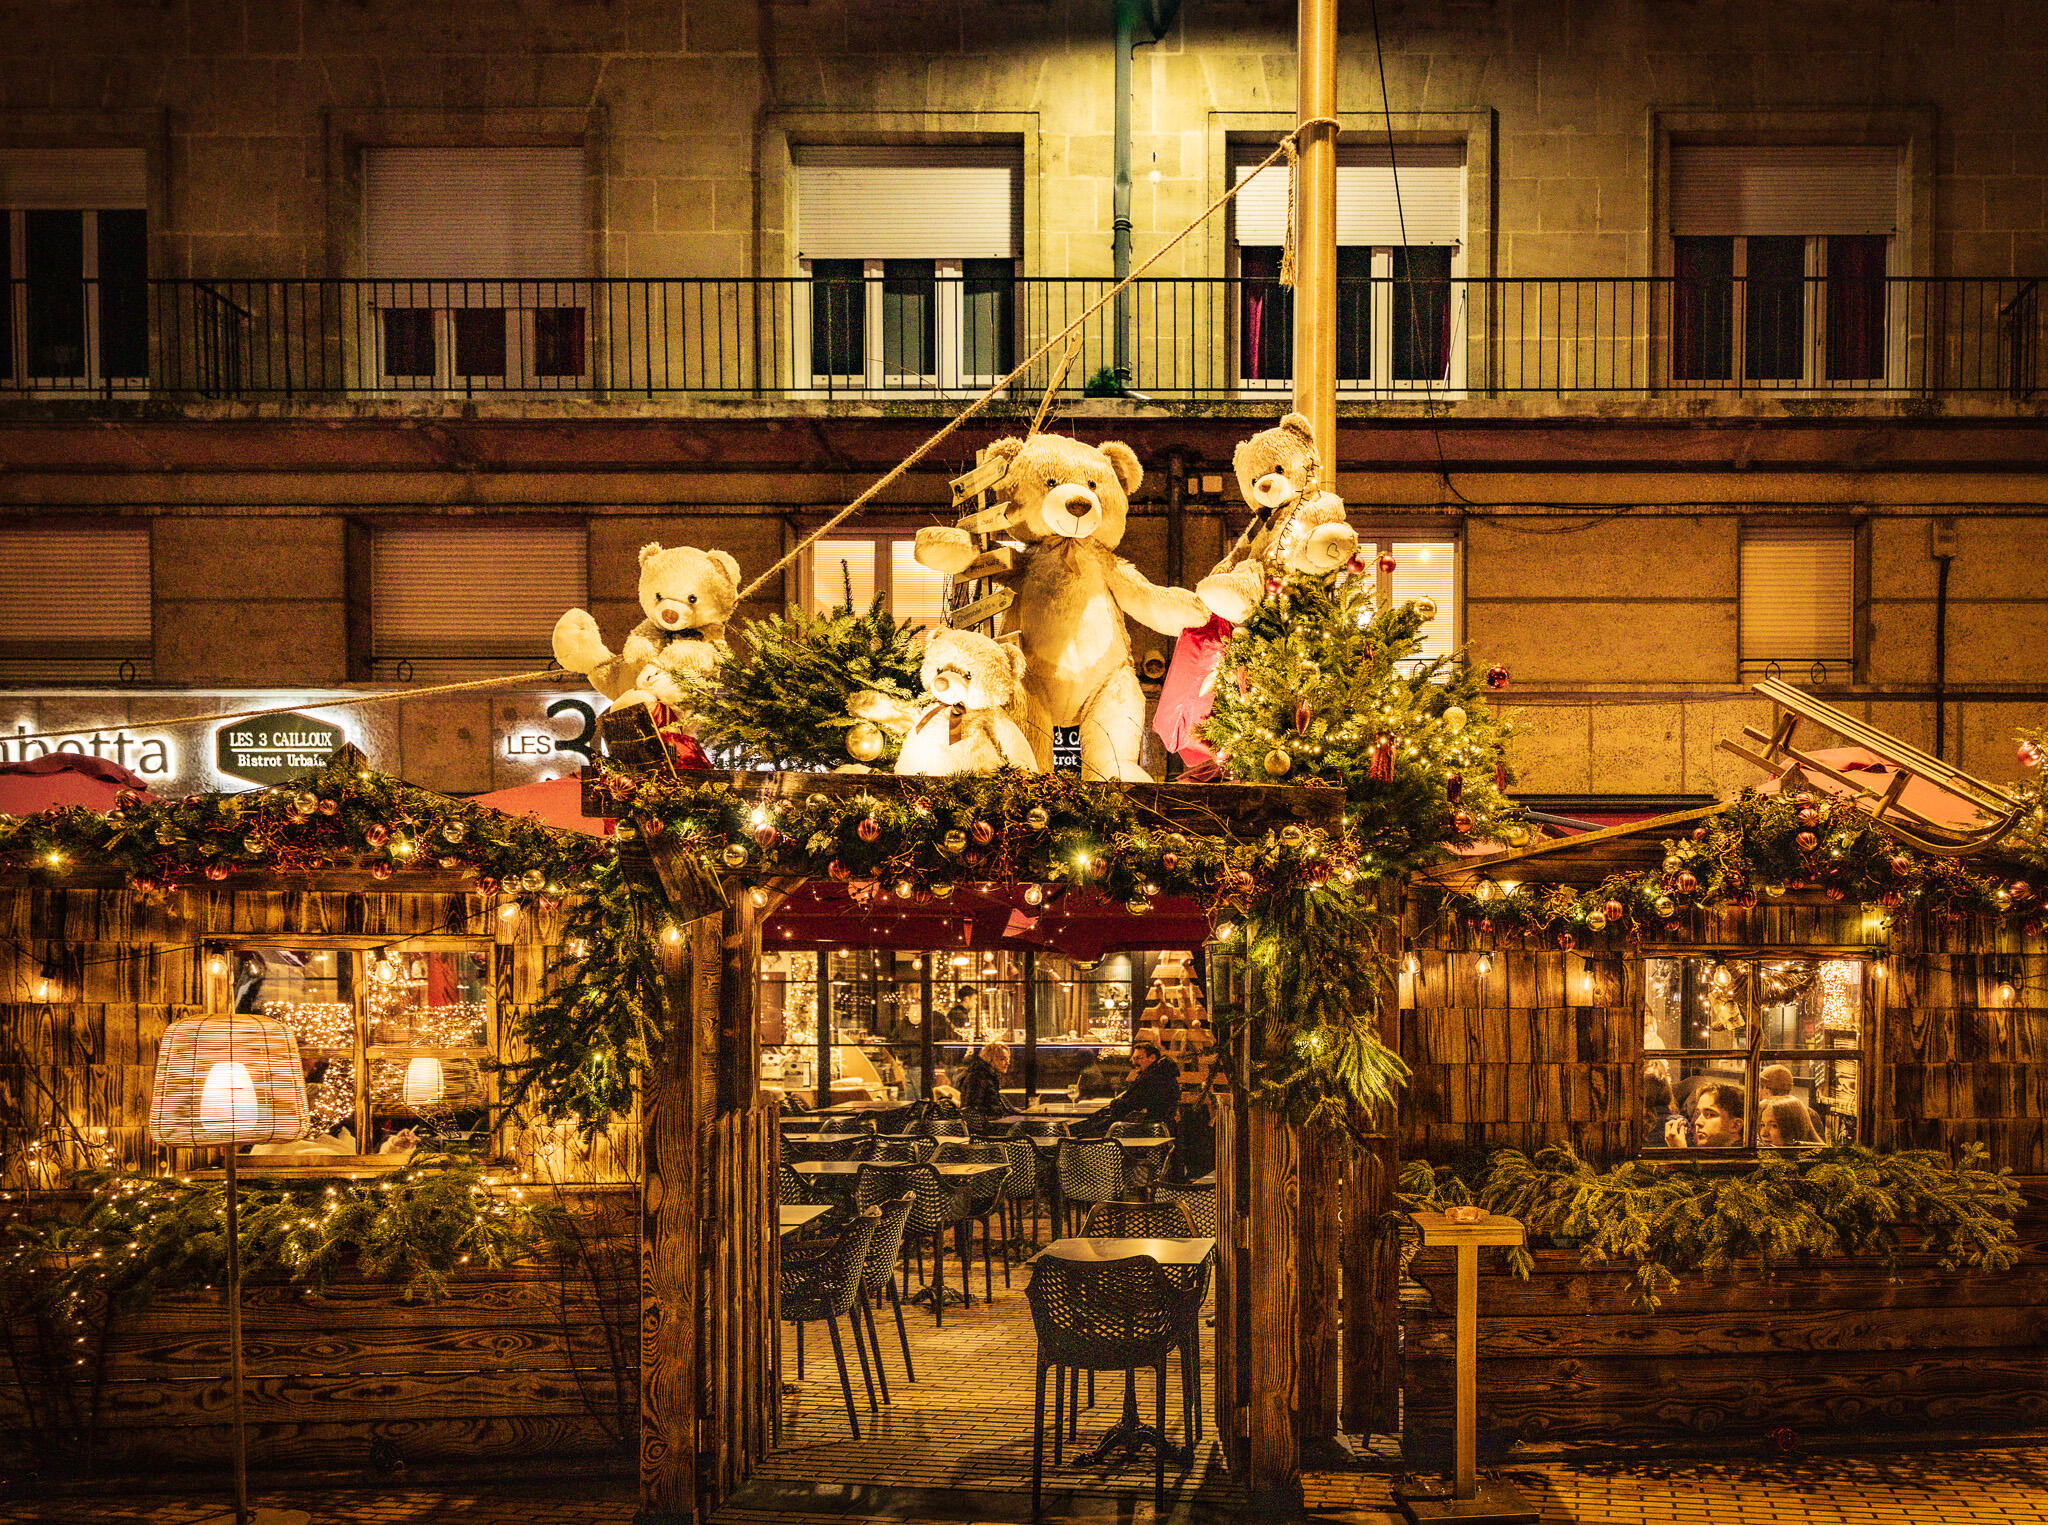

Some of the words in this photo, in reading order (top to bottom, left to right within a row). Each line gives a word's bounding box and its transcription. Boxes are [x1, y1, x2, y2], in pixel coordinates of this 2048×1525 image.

[507, 735, 551, 755] LES
[547, 698, 597, 766] 3
[1054, 731, 1064, 745] 3
[229, 732, 254, 747] LES
[258, 732, 268, 747] 3
[272, 732, 333, 747] CAILLOUX
[237, 753, 282, 767] Bistrot
